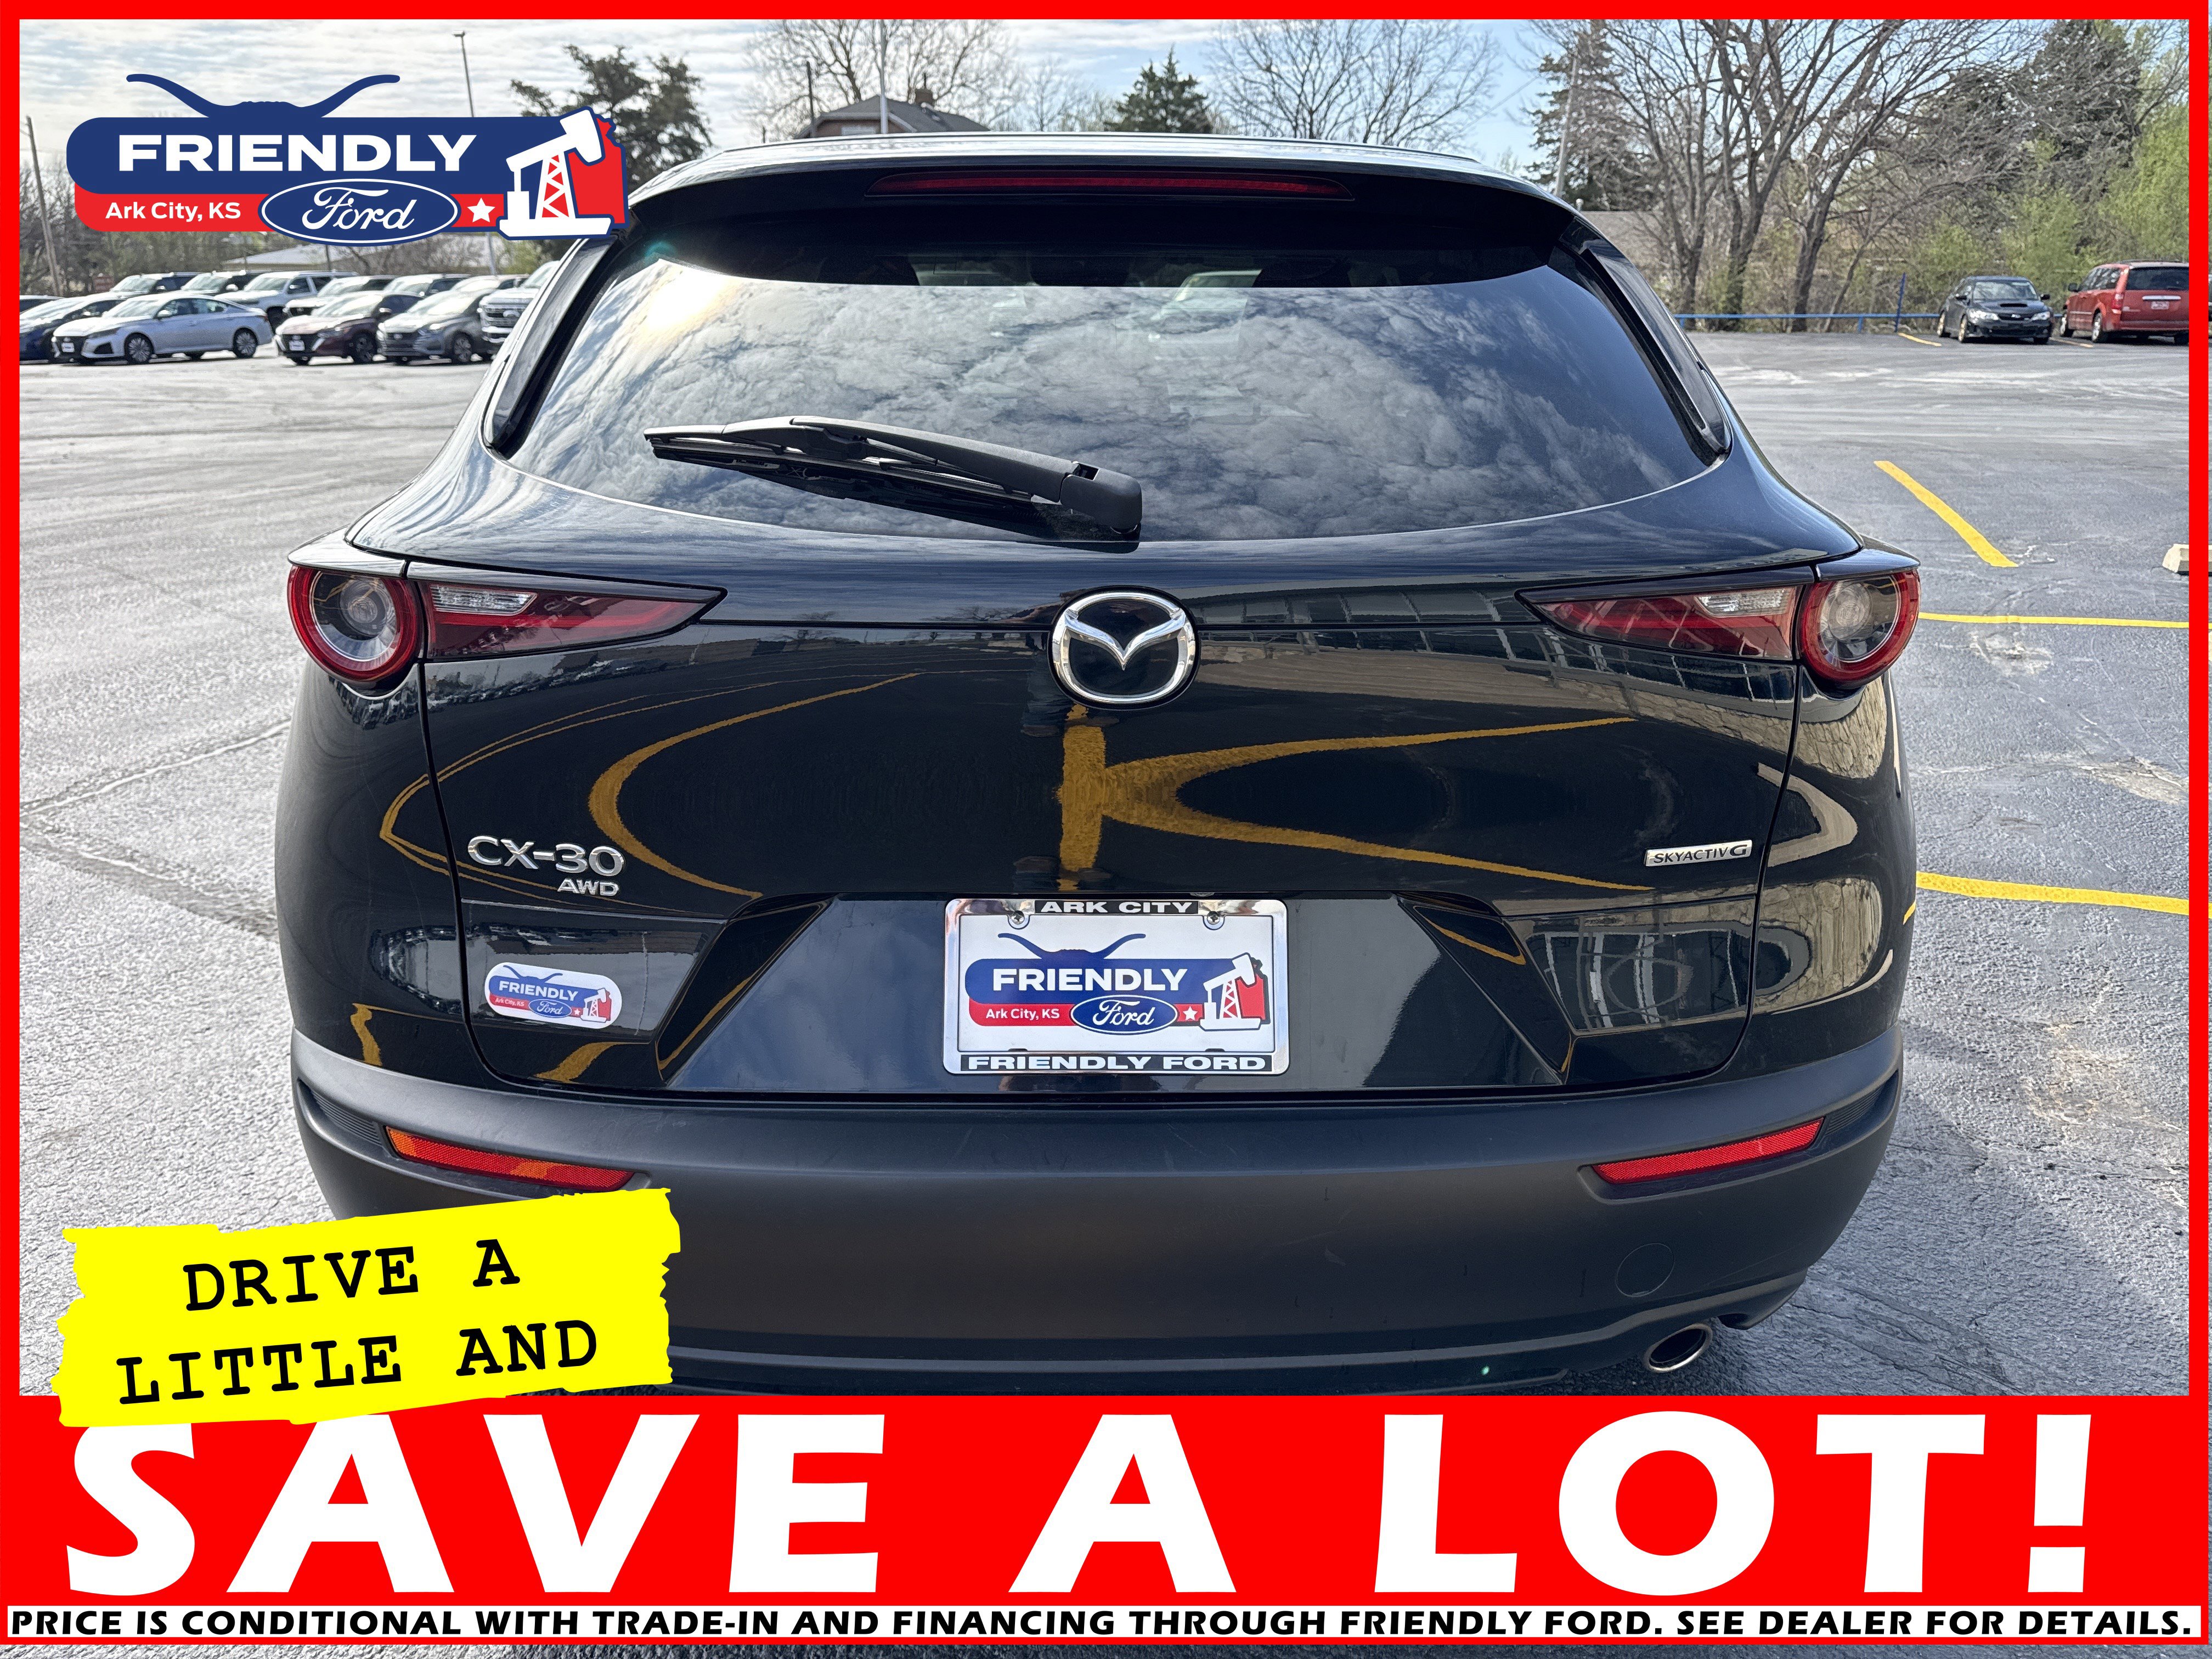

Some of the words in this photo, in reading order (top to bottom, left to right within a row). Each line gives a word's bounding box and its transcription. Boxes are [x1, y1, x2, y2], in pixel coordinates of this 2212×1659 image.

[468, 836, 625, 876] CX-30
[557, 878, 619, 896] AWD
[1041, 901, 1109, 913] ARK
[1118, 901, 1194, 913] CITY
[992, 969, 1188, 991] FRIENDLY
[499, 980, 578, 1001] FRIENDLY
[537, 1000, 563, 1015] Ford
[986, 1009, 1008, 1019] Ark
[1010, 1008, 1040, 1021] City,
[1042, 1008, 1060, 1019] KS
[1092, 1000, 1155, 1026] Ford
[968, 1057, 1153, 1070] FRIENDLY
[1163, 1057, 1266, 1070] FORD
